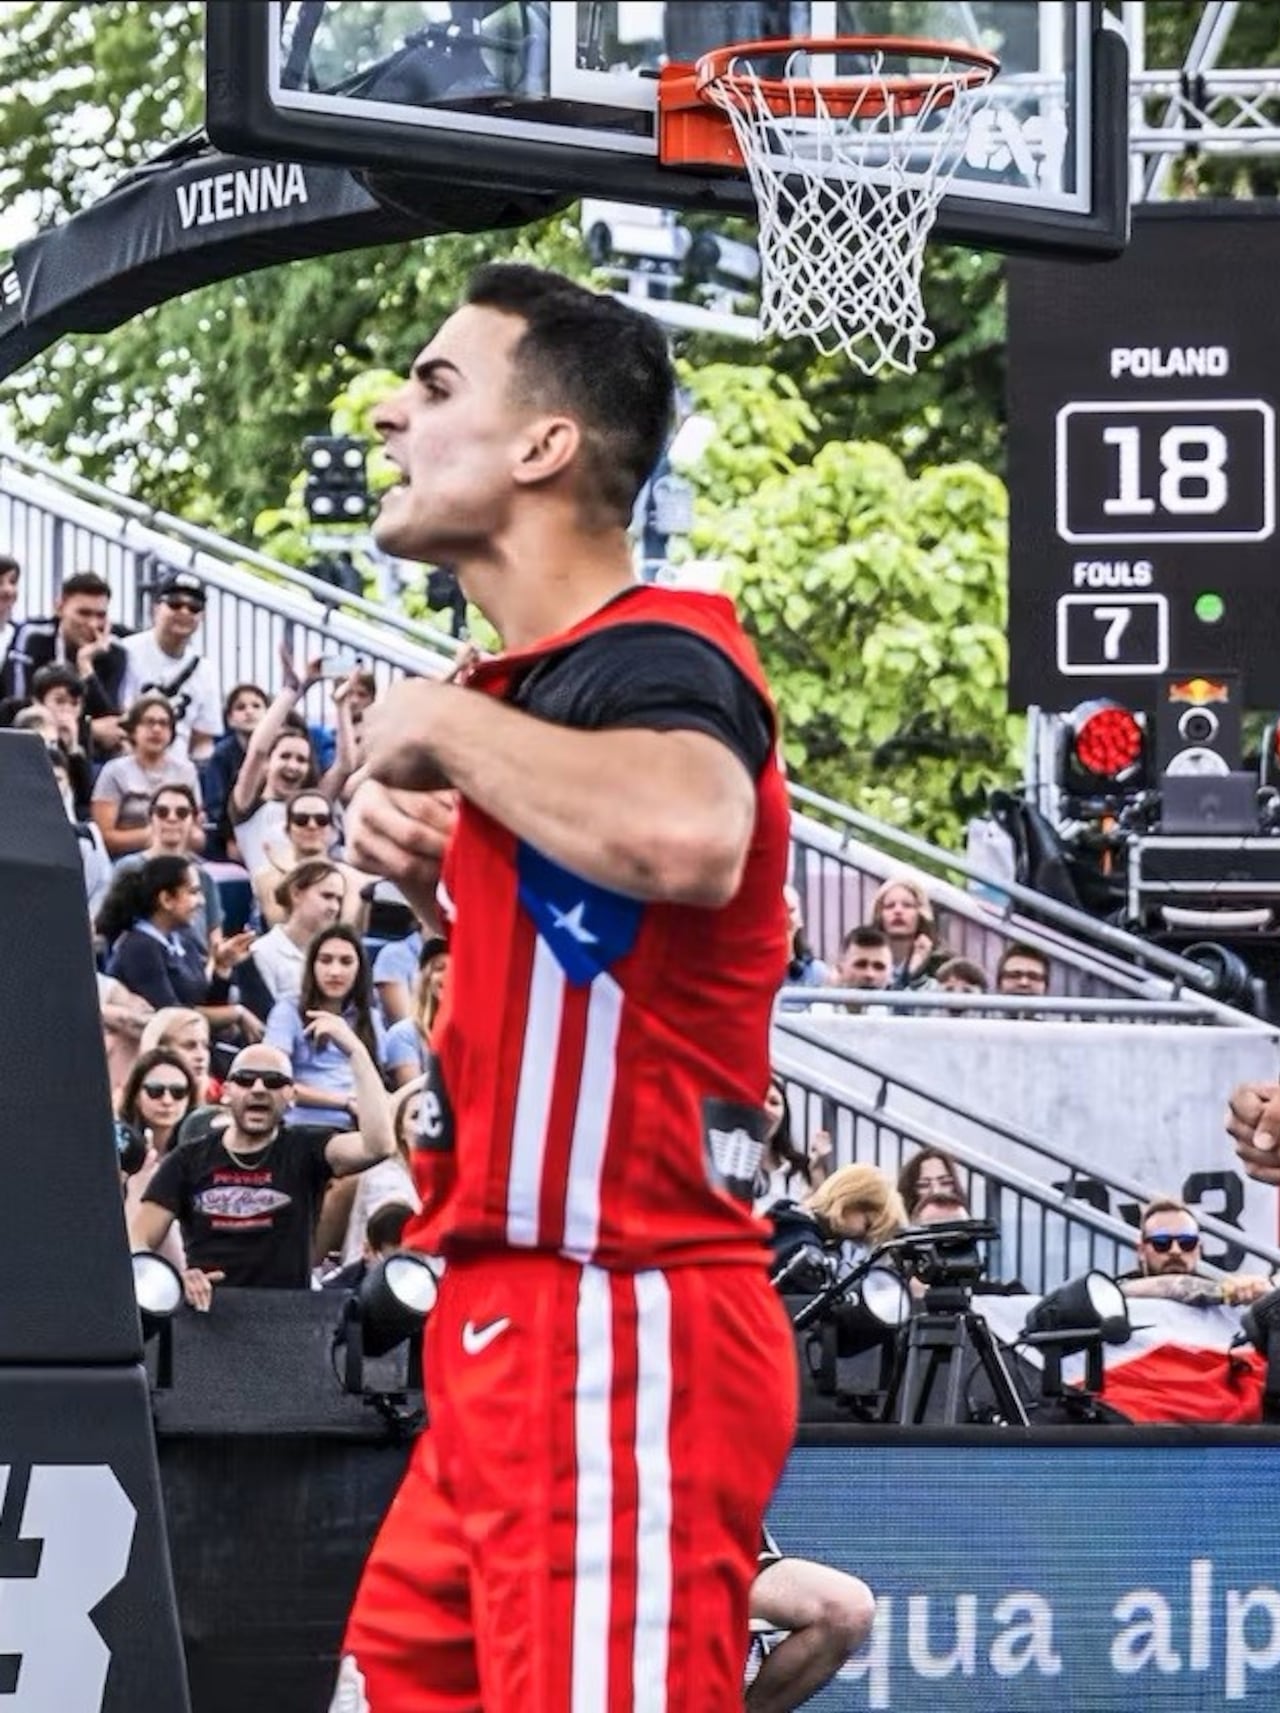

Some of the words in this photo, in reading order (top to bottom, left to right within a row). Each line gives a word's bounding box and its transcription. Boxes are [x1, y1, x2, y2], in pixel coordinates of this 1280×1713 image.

[176, 163, 309, 230] VIENNA
[1111, 347, 1229, 377] POLAND
[1103, 425, 1228, 515] 18
[1073, 561, 1153, 587] FOULS
[1093, 606, 1132, 660] 7
